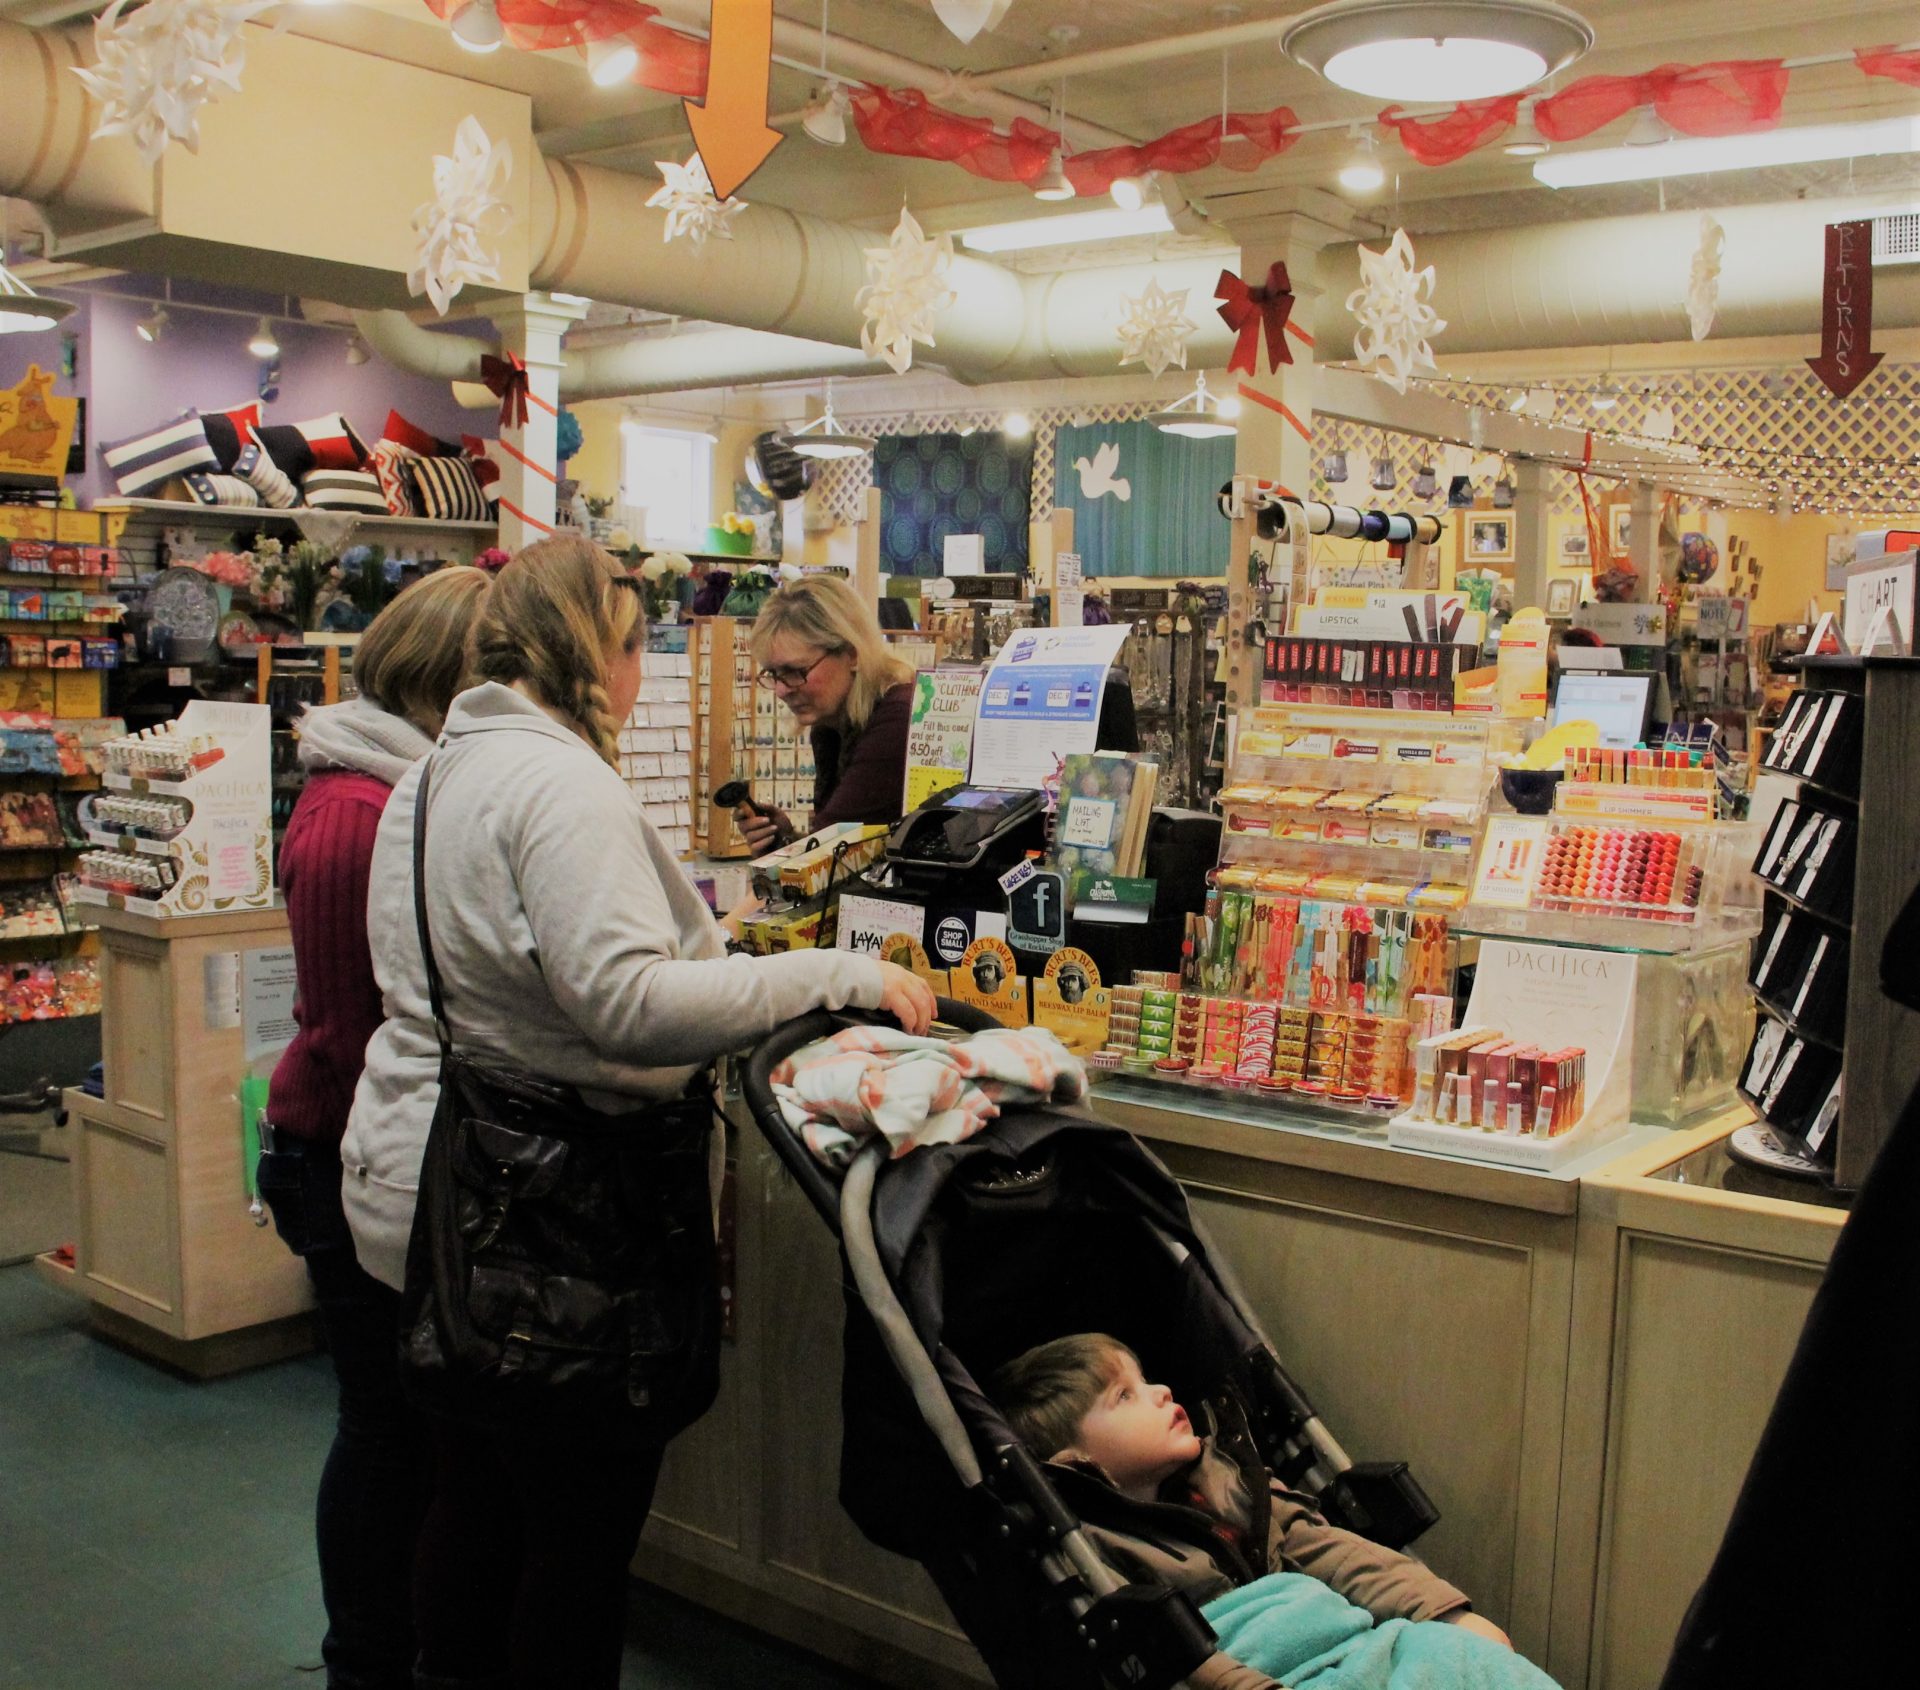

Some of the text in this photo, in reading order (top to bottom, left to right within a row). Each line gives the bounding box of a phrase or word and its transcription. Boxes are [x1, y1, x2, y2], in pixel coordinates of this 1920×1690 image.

[1836, 226, 1856, 377] RETURNS
[1319, 616, 1359, 624] LIPSTICK
[909, 743, 930, 756] $50
[1072, 806, 1102, 818] MAILING
[850, 930, 884, 952] LAYA
[942, 930, 962, 940] SHOP
[940, 938, 964, 949] SMALL
[963, 938, 1015, 974] BURT'S BEES
[1506, 946, 1608, 979] PACIFICA
[1045, 949, 1100, 985] BURT'S BEES
[990, 1000, 1015, 1012] SALVE
[1038, 1001, 1072, 1013] BEESWAX
[1086, 1008, 1108, 1018] BALM
